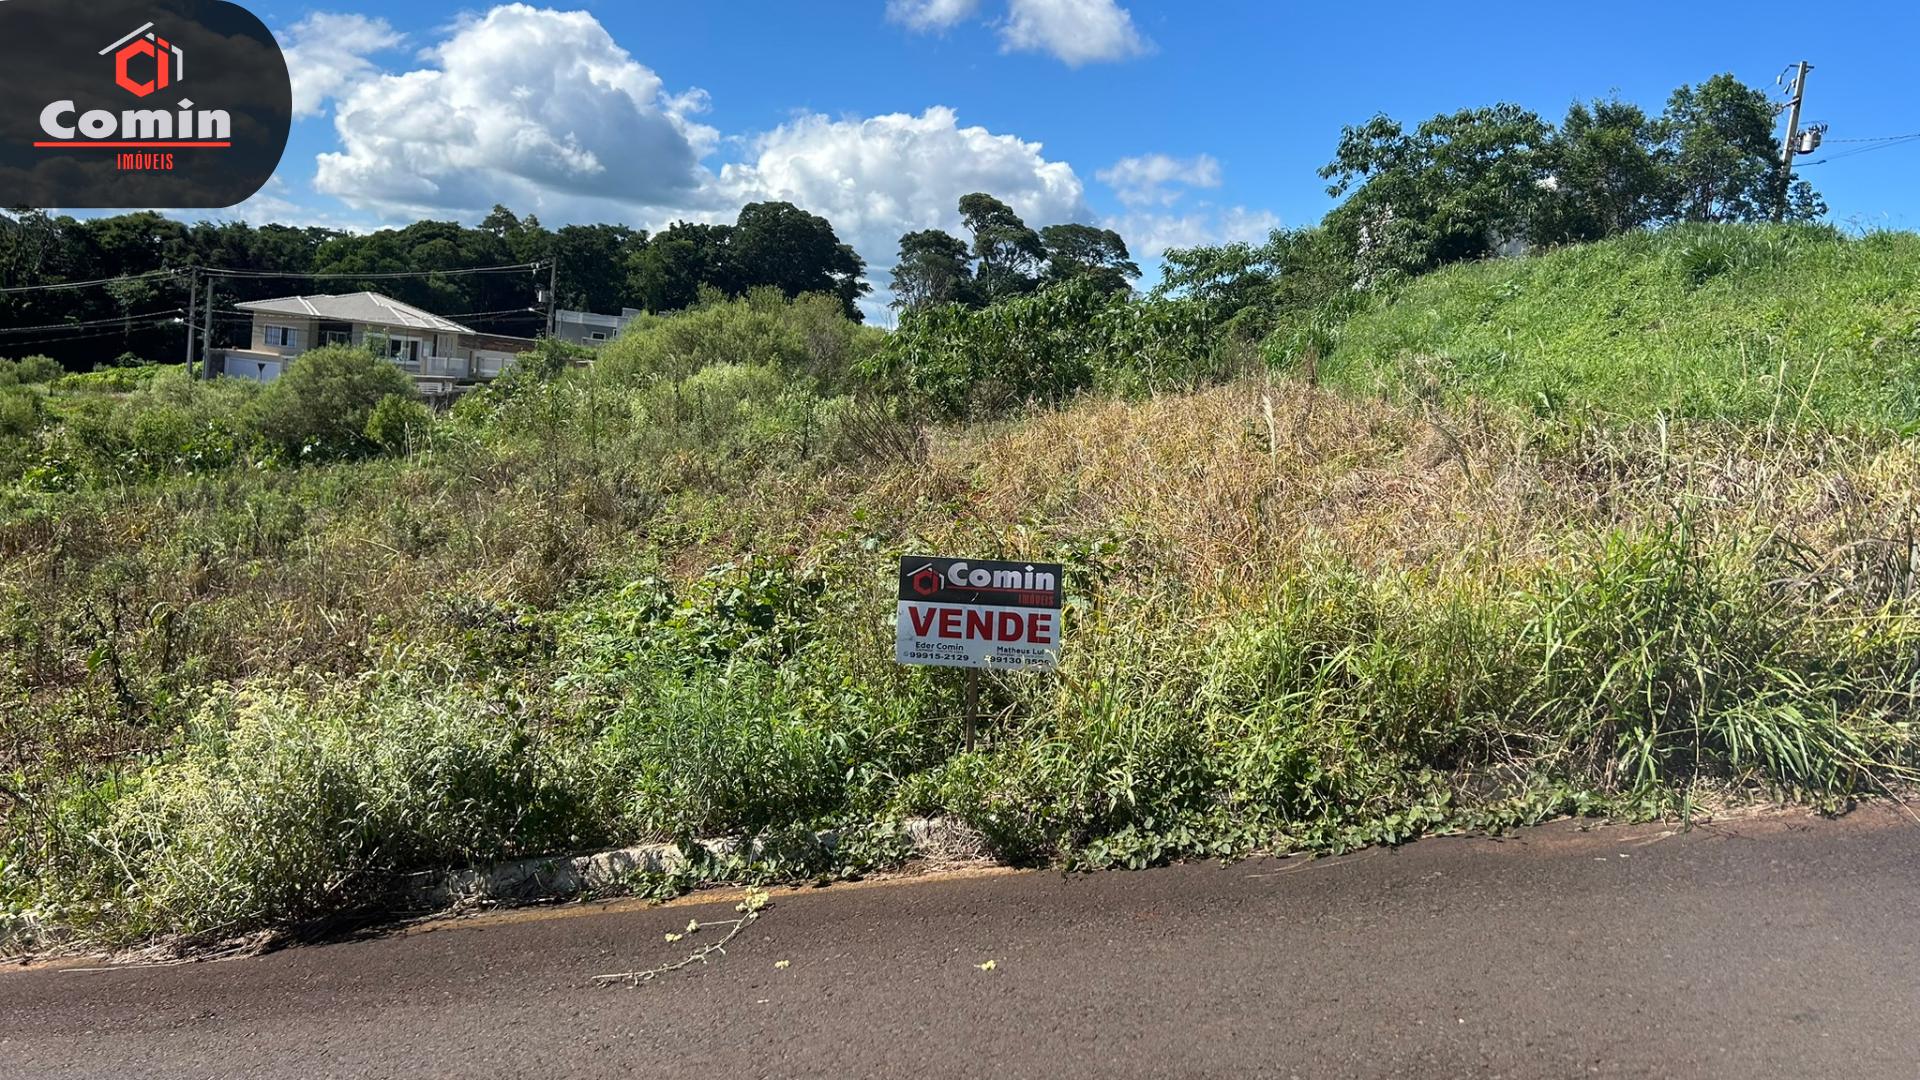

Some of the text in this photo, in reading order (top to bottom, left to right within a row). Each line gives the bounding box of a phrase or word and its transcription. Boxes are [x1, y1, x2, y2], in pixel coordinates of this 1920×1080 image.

[947, 562, 1055, 590] Comin
[908, 606, 1052, 644] VENDE
[915, 641, 964, 651] Eder Comin
[996, 646, 1030, 655] Matheus
[909, 651, 969, 661] 99915-2129
